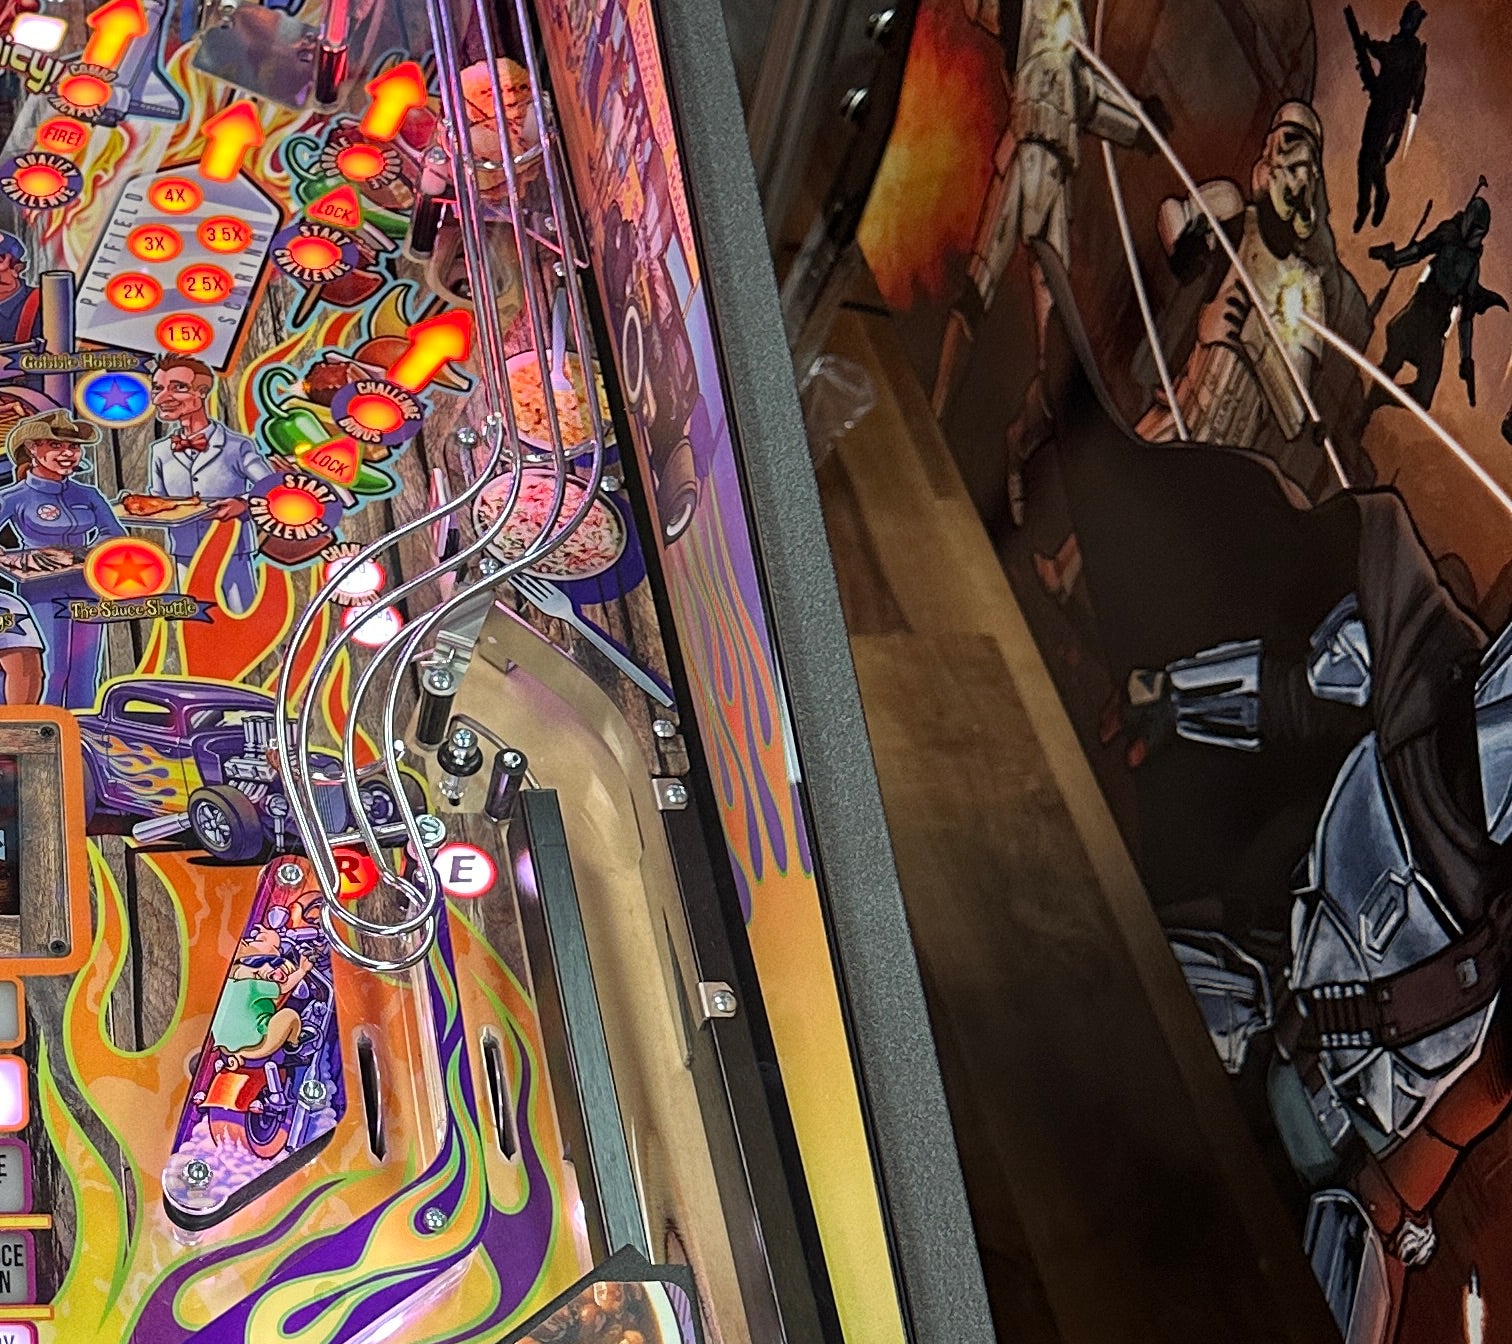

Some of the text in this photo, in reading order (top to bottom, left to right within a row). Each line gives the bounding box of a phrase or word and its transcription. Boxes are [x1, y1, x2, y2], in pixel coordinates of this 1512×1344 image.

[43, 126, 82, 147] FIRE!
[164, 188, 186, 203] 4X
[317, 203, 354, 222] LOCK
[144, 236, 165, 252] 3X
[299, 224, 353, 246] START
[123, 283, 145, 300] 2X
[168, 326, 203, 343] 1.5X
[310, 450, 351, 477] LOCK
[71, 597, 197, 619] The Sauce Shuttle
